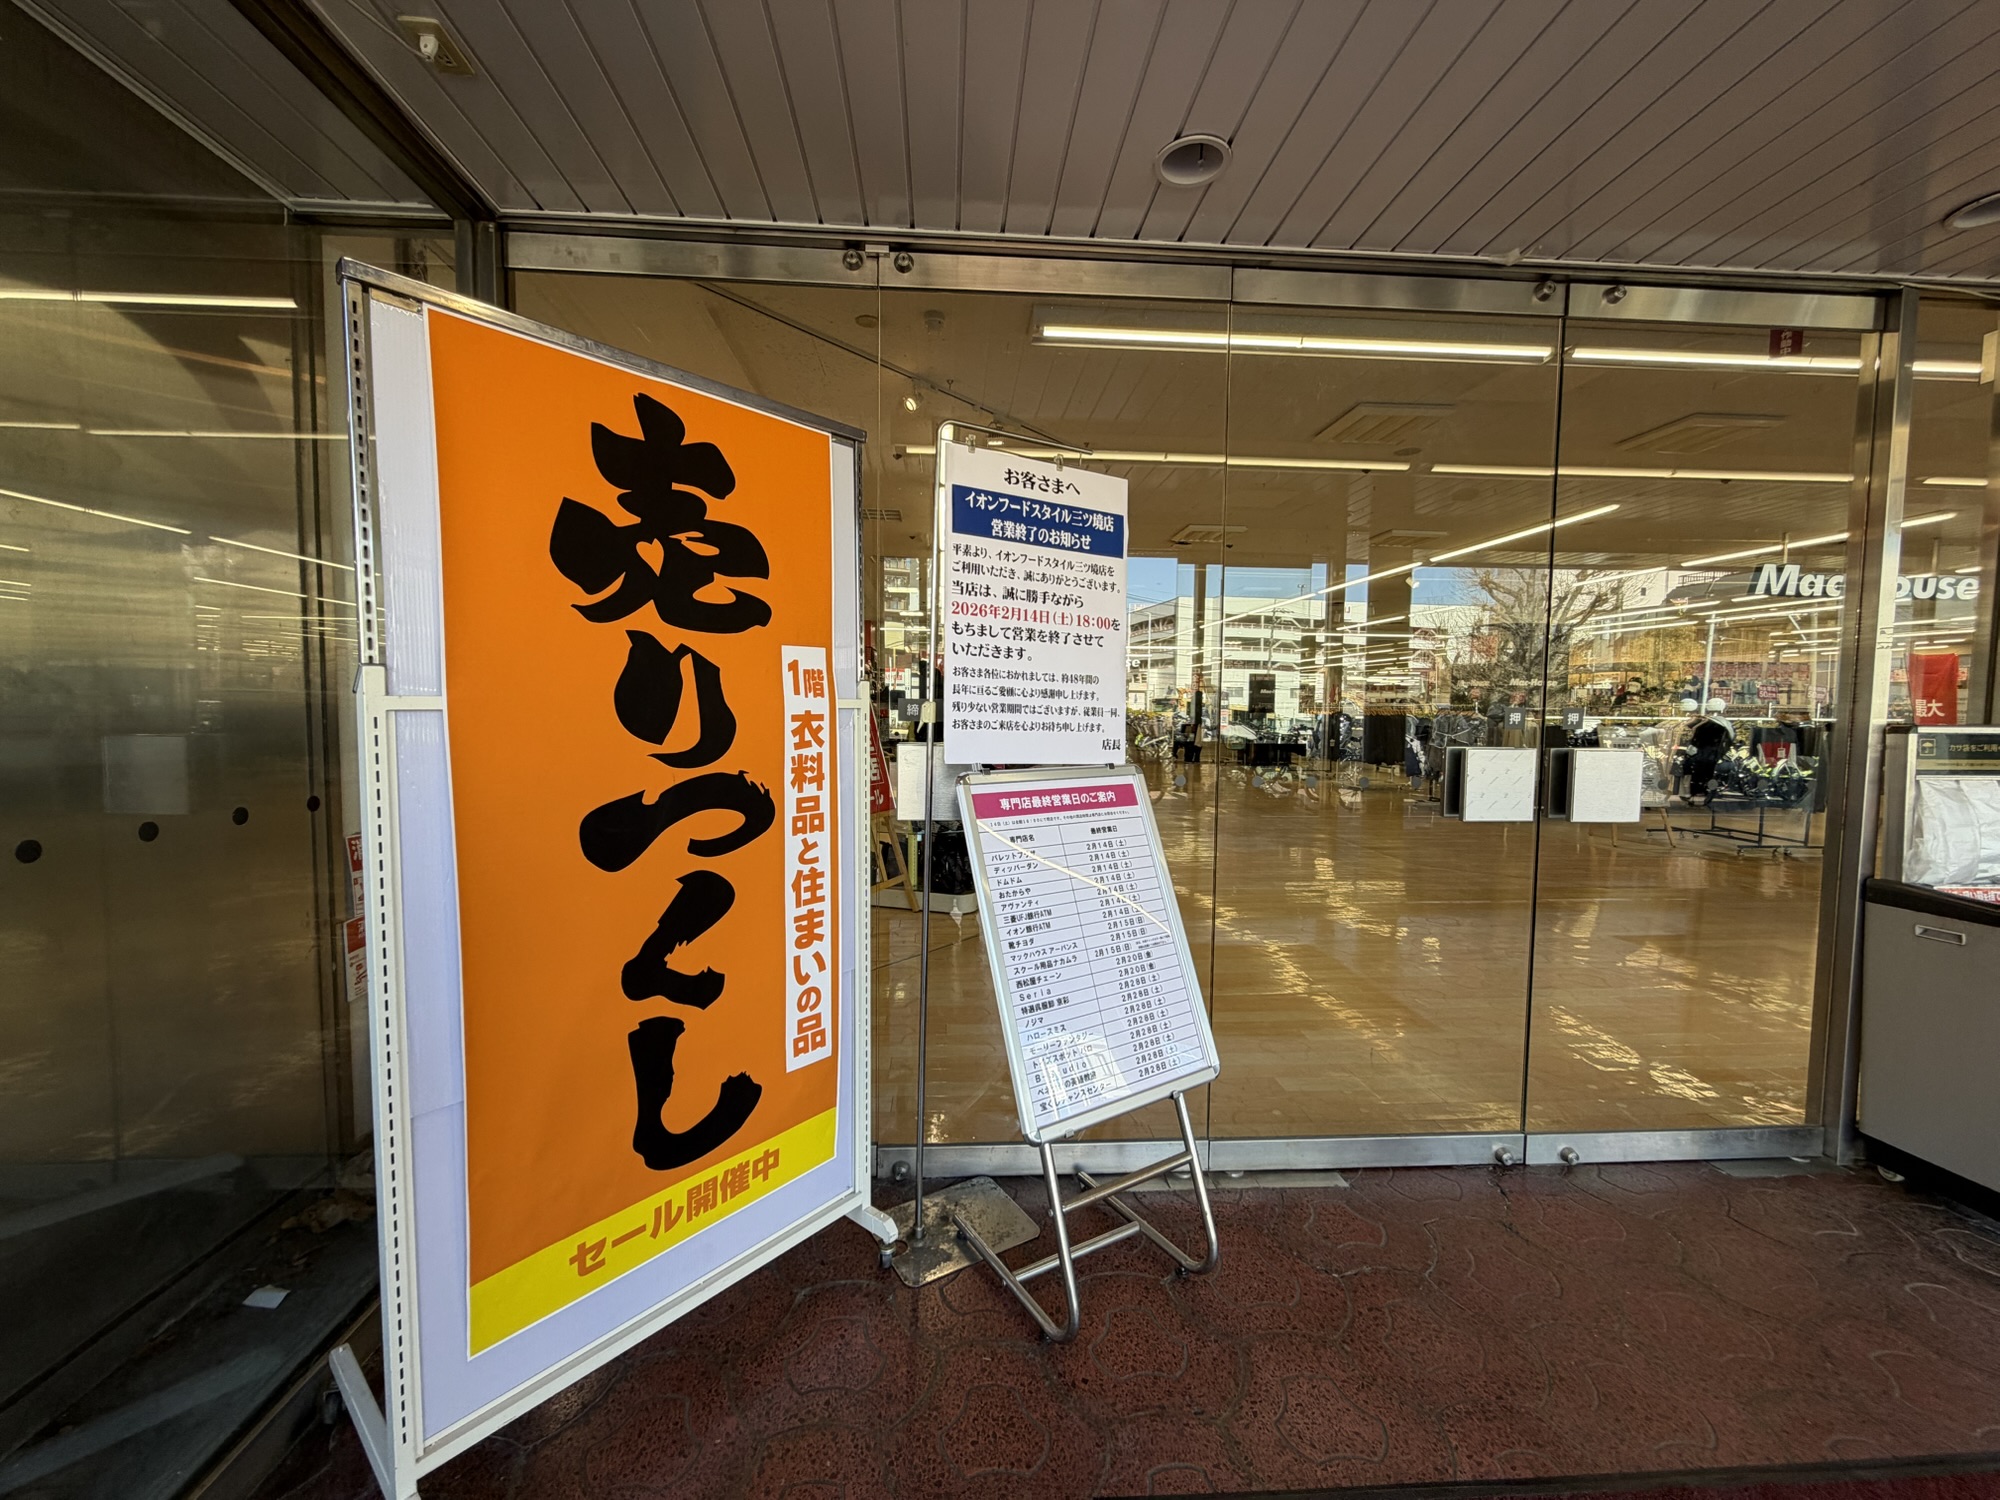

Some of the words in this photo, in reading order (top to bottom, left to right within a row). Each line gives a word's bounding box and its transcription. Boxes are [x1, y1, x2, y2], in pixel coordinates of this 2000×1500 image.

[1004, 468, 1081, 495] お客さまへ
[965, 491, 1115, 532] イオンフードスタイル三ツ境店
[991, 519, 1092, 550] 営業終了のお知らせ
[952, 561, 1121, 594] ご利用いただき、誠にありがとうございます。
[952, 581, 1084, 608] 当店は、誠に勝手ながら
[952, 621, 1105, 647] もちまして営業を終了させて
[952, 643, 1032, 661] いただきます。
[1915, 699, 1945, 717] 最大
[1509, 712, 1521, 725] 押
[1567, 712, 1579, 725] 押
[1101, 738, 1121, 751] 店長
[549, 393, 776, 1171] 売りつくし
[999, 791, 1117, 811] 専門店最終営業日のご案内
[1009, 834, 1035, 844] 専門店名
[1090, 825, 1118, 835] 最終営業日
[996, 877, 1023, 887] ドムドム
[999, 888, 1032, 899] おたからや
[1016, 972, 1062, 989] 西松屋チェーン
[1025, 1016, 1044, 1028] ノジマ
[569, 1147, 780, 1277] セール開催中
